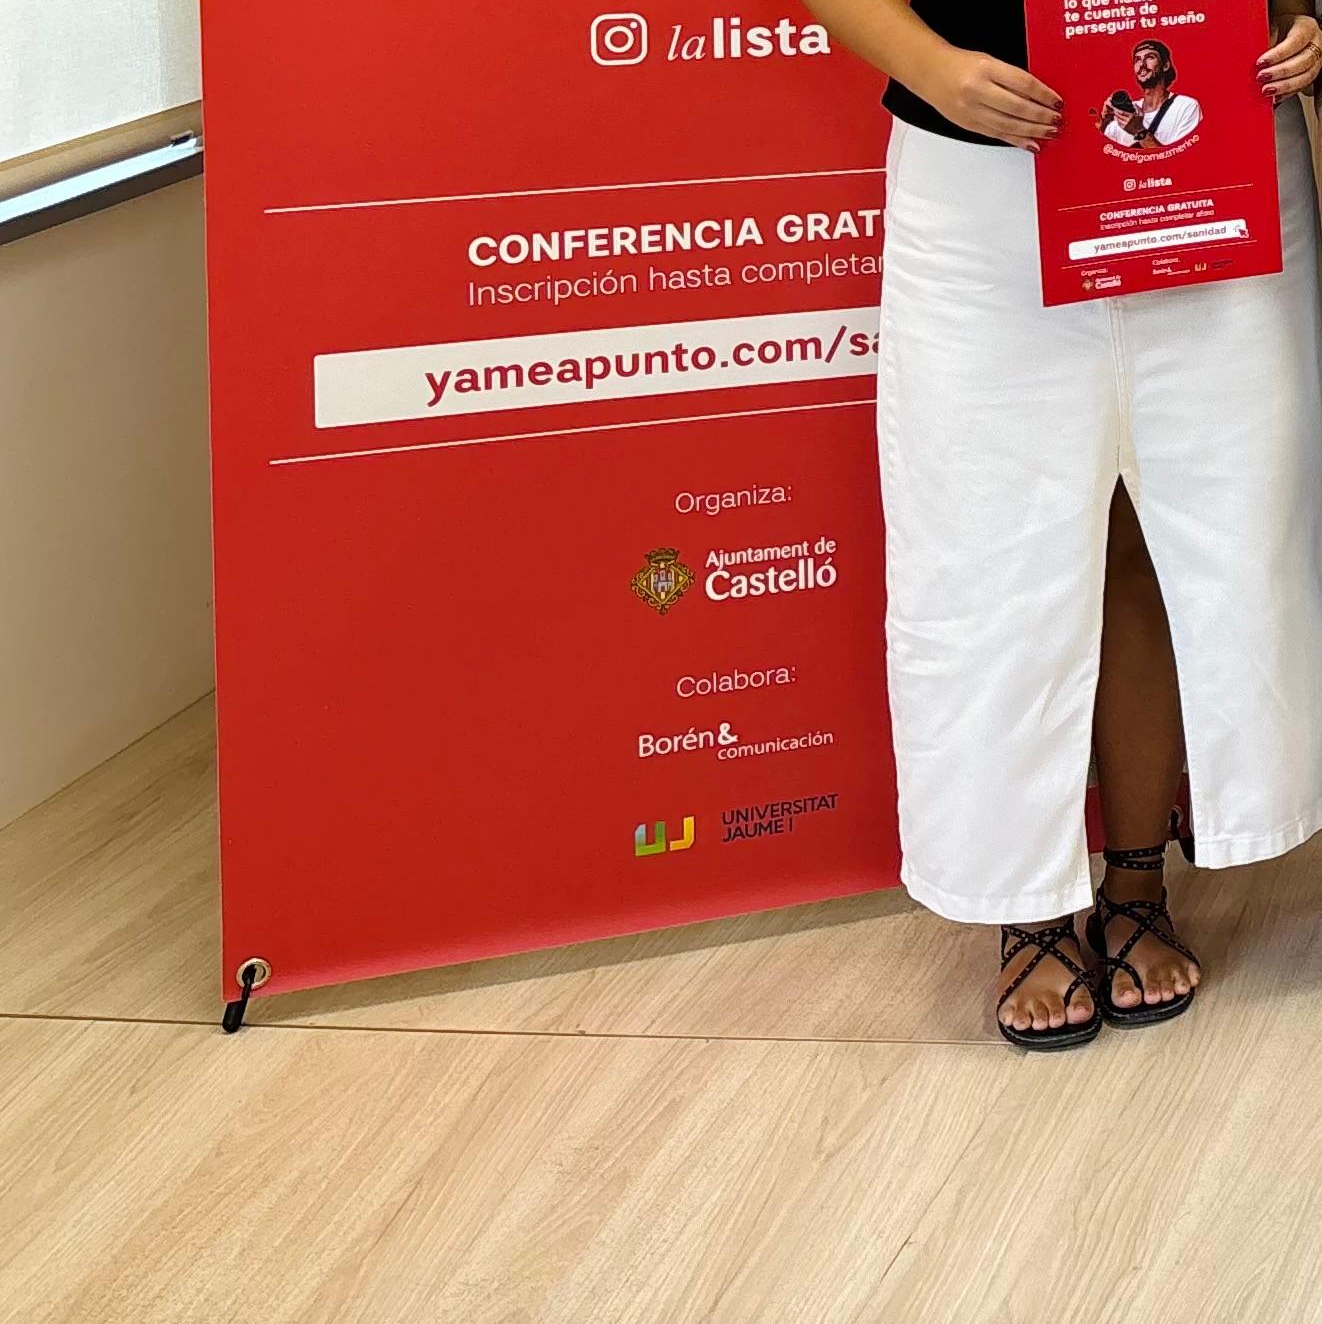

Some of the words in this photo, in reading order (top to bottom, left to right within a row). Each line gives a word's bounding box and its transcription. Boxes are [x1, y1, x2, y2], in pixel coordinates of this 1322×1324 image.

[1064, 10, 1080, 22] te
[1084, 5, 1136, 21] cuenta
[1139, 3, 1158, 15] de
[1065, 18, 1137, 38] perseguir
[1140, 16, 1157, 28] tu
[1160, 10, 1205, 27] sueño
[468, 218, 763, 266] CONFERENCIA
[774, 207, 887, 245] GRAT
[470, 269, 637, 306] Inscripción
[650, 265, 731, 290] hasta
[675, 485, 791, 515] Organiza:
[706, 541, 809, 573] Ajuntament
[814, 537, 836, 554] de
[705, 556, 836, 600] Castelló
[677, 667, 795, 697] Colabora:
[716, 731, 834, 761] comunicación
[720, 794, 839, 826] UNIVERSITAT
[721, 820, 785, 843] JAUME
